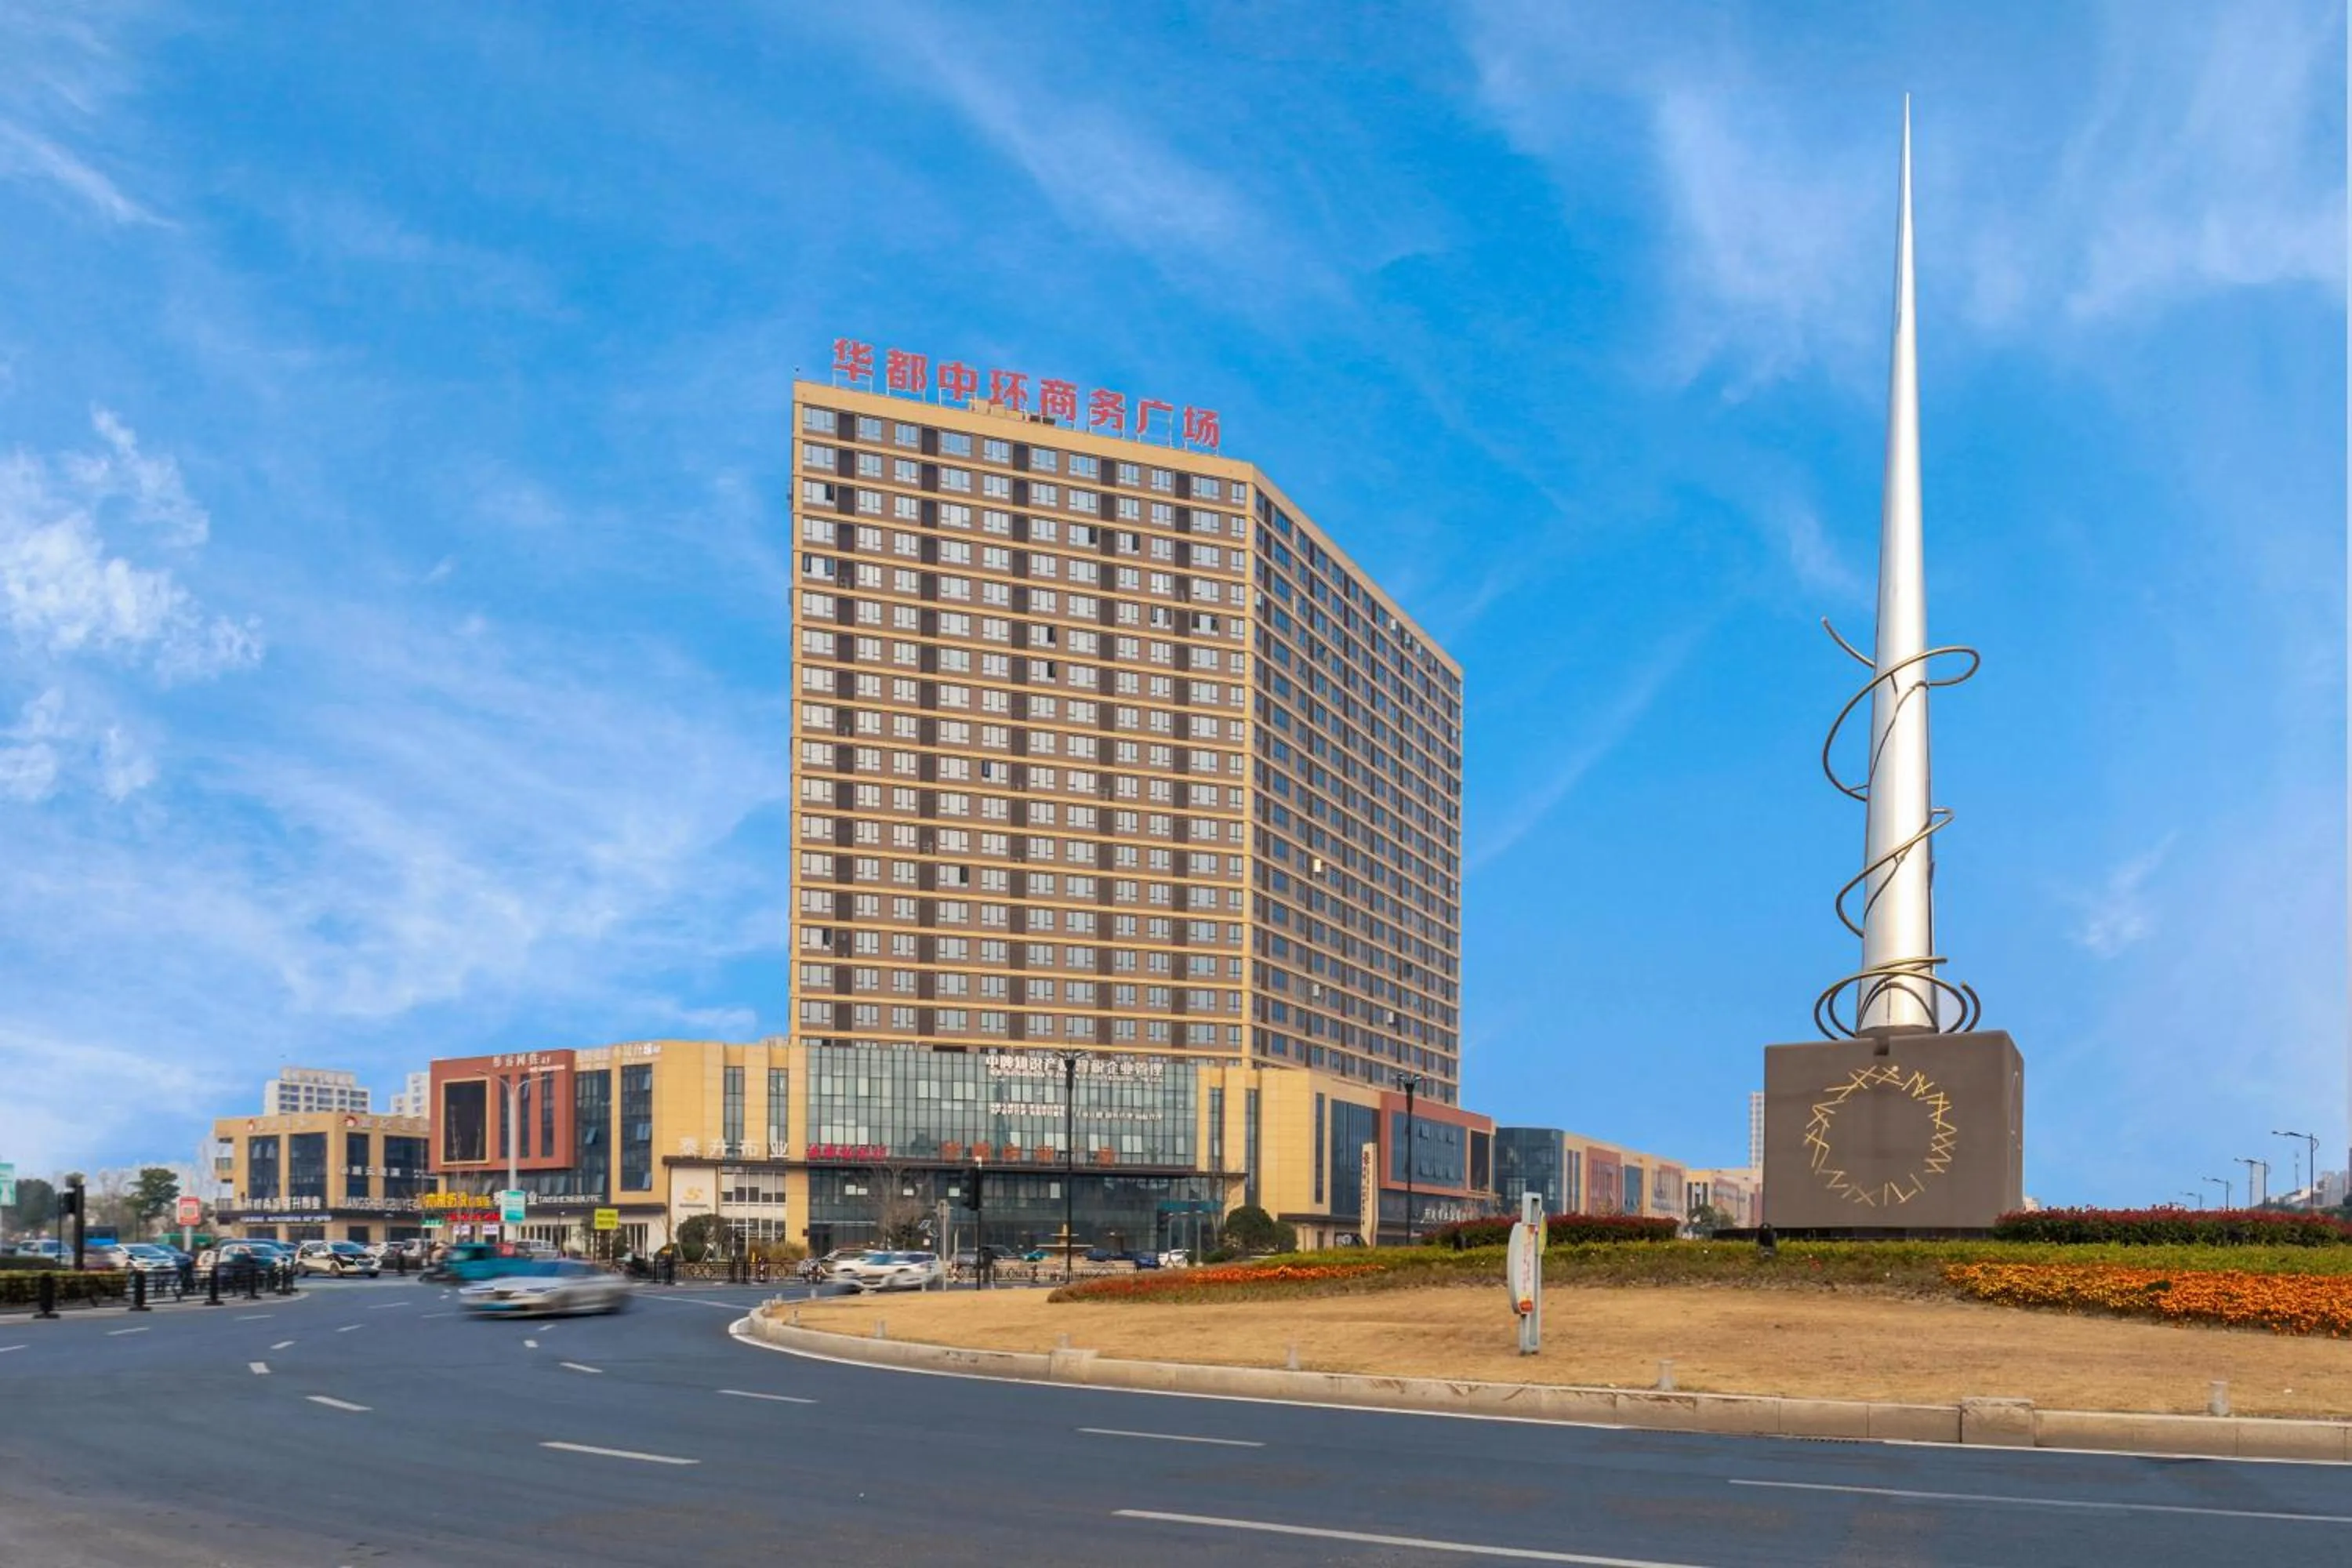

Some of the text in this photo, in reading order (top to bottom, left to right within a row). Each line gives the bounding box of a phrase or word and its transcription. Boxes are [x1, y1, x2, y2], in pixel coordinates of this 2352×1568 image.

[833, 337, 1221, 448] 华都中环商务广场
